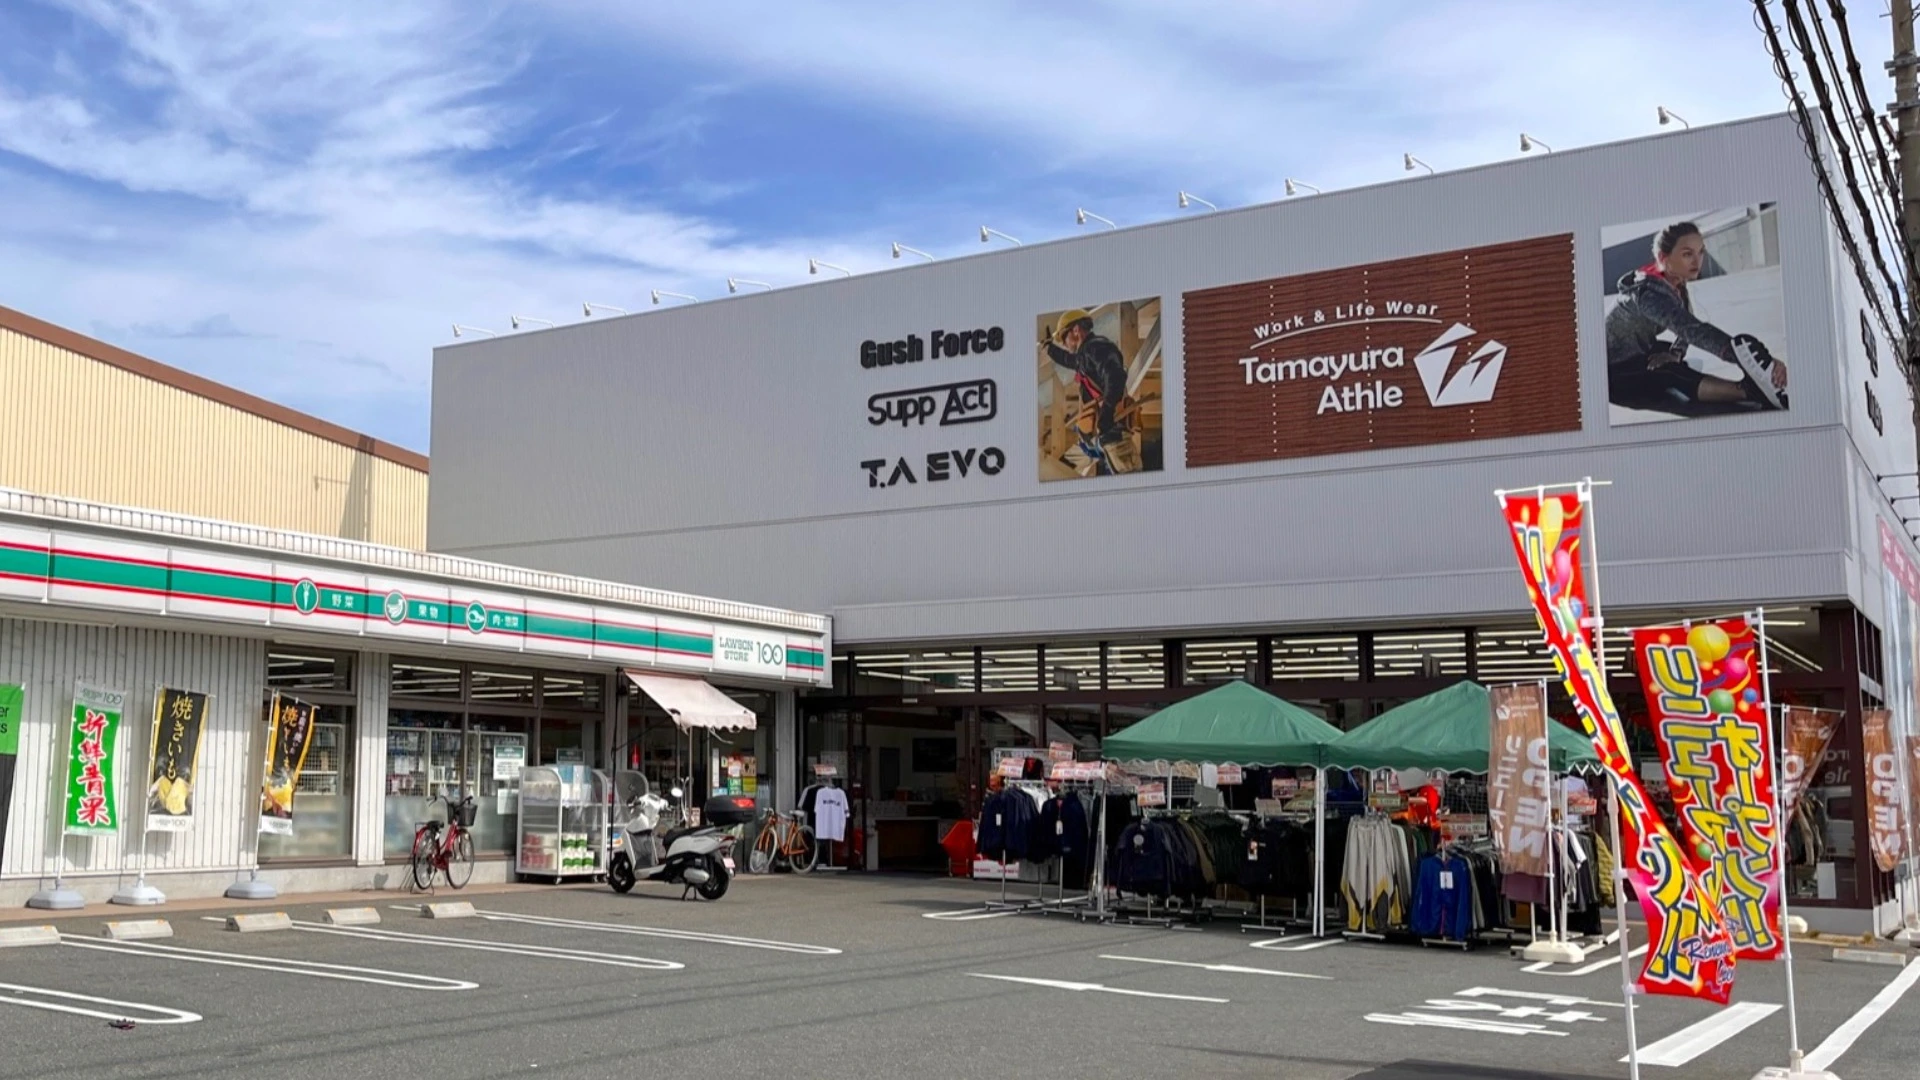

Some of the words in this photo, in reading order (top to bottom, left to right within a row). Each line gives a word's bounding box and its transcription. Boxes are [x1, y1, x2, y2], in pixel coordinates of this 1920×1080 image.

[1254, 315, 1304, 339] Work
[1314, 310, 1325, 323] &
[1336, 303, 1375, 320] Life
[1386, 300, 1439, 316] Wear
[860, 333, 924, 369] Gush
[931, 326, 1004, 359] Force
[1239, 346, 1404, 384] Tamayura
[1317, 380, 1403, 415] Athle
[860, 456, 918, 488] T.A
[927, 446, 1006, 482] EVO
[332, 593, 355, 608] 野菜
[418, 604, 439, 619] 果物
[719, 636, 754, 651] LAWSON
[757, 641, 783, 666] 100
[724, 650, 749, 661] STORE
[168, 695, 194, 780] 焼きいも
